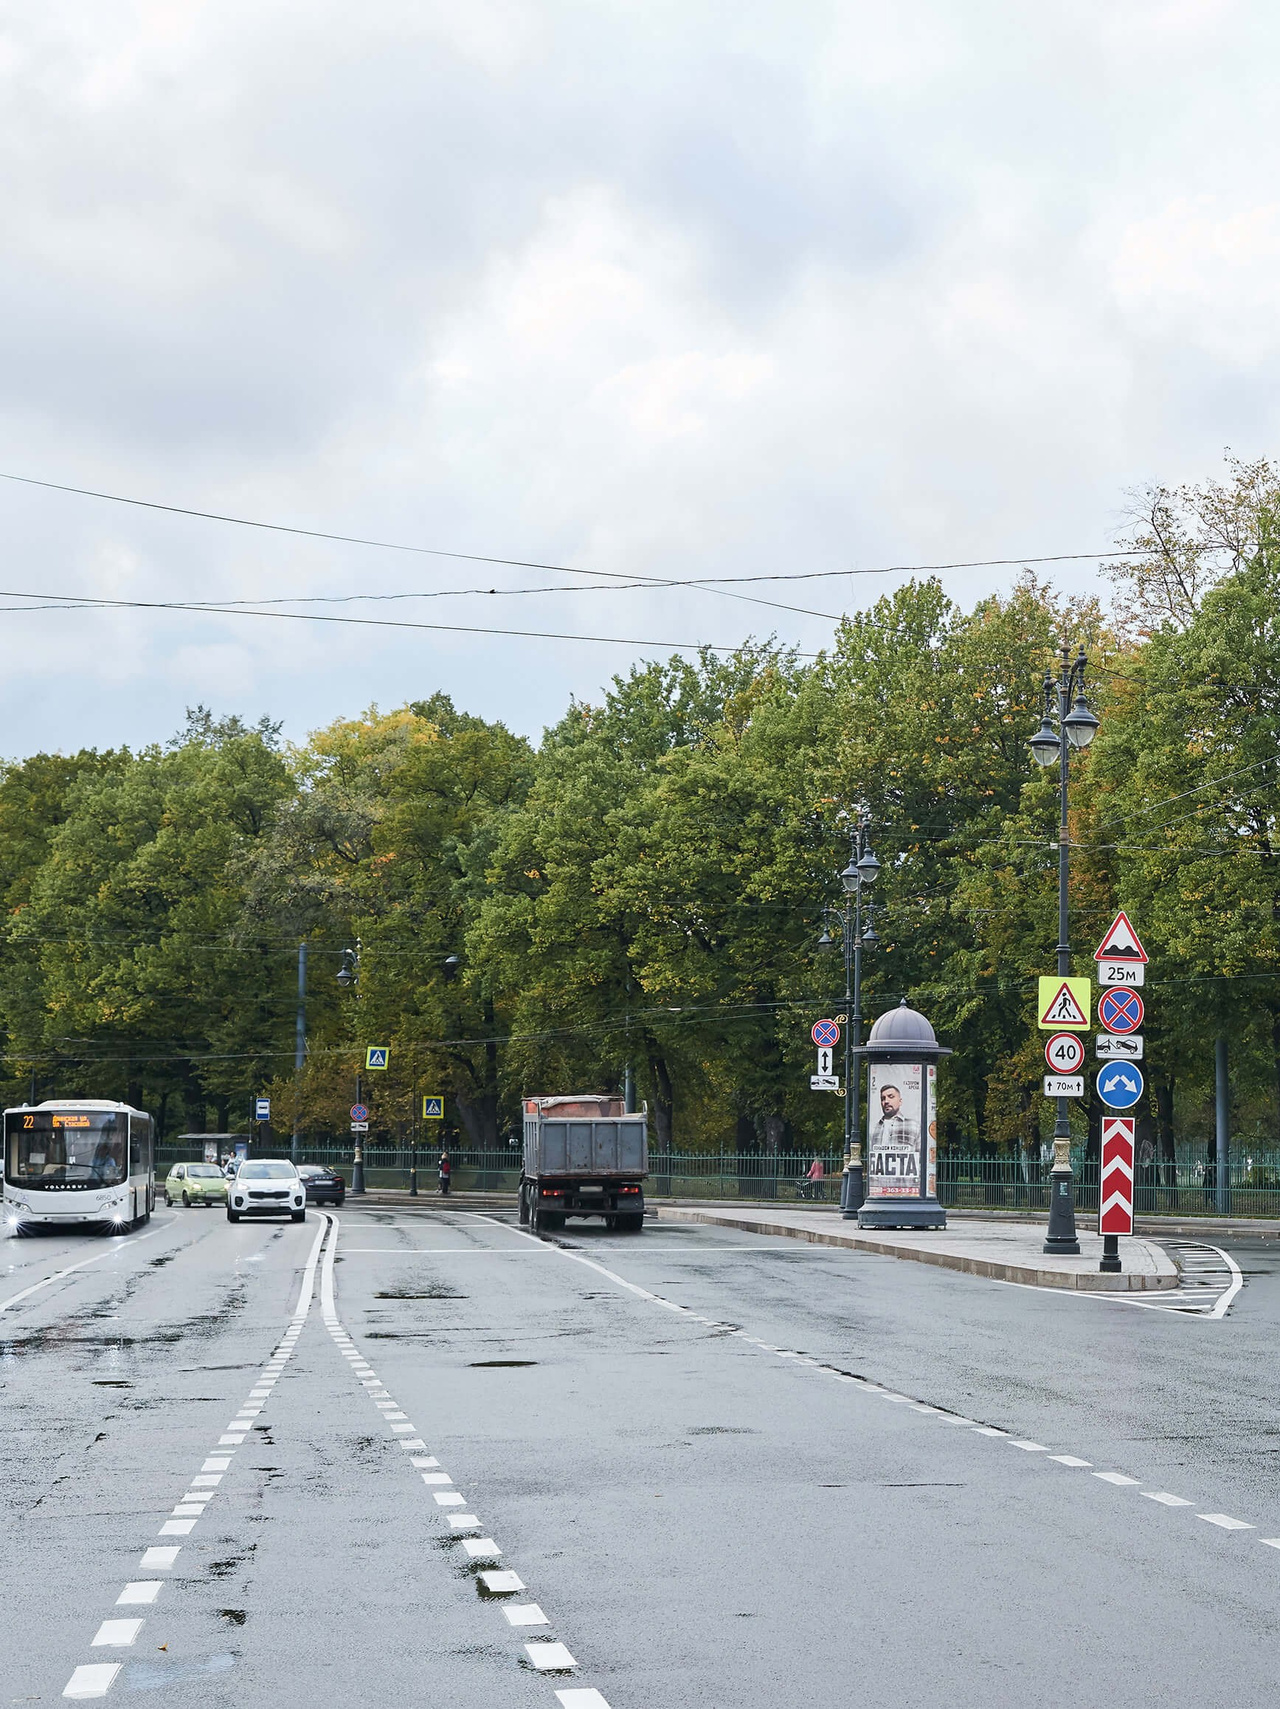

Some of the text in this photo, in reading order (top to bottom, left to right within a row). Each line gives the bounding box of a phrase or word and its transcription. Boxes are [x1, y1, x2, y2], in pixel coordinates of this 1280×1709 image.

[1055, 1045, 1076, 1060] 40
[23, 1115, 34, 1128] 22
[870, 1153, 917, 1176] БАСТА
